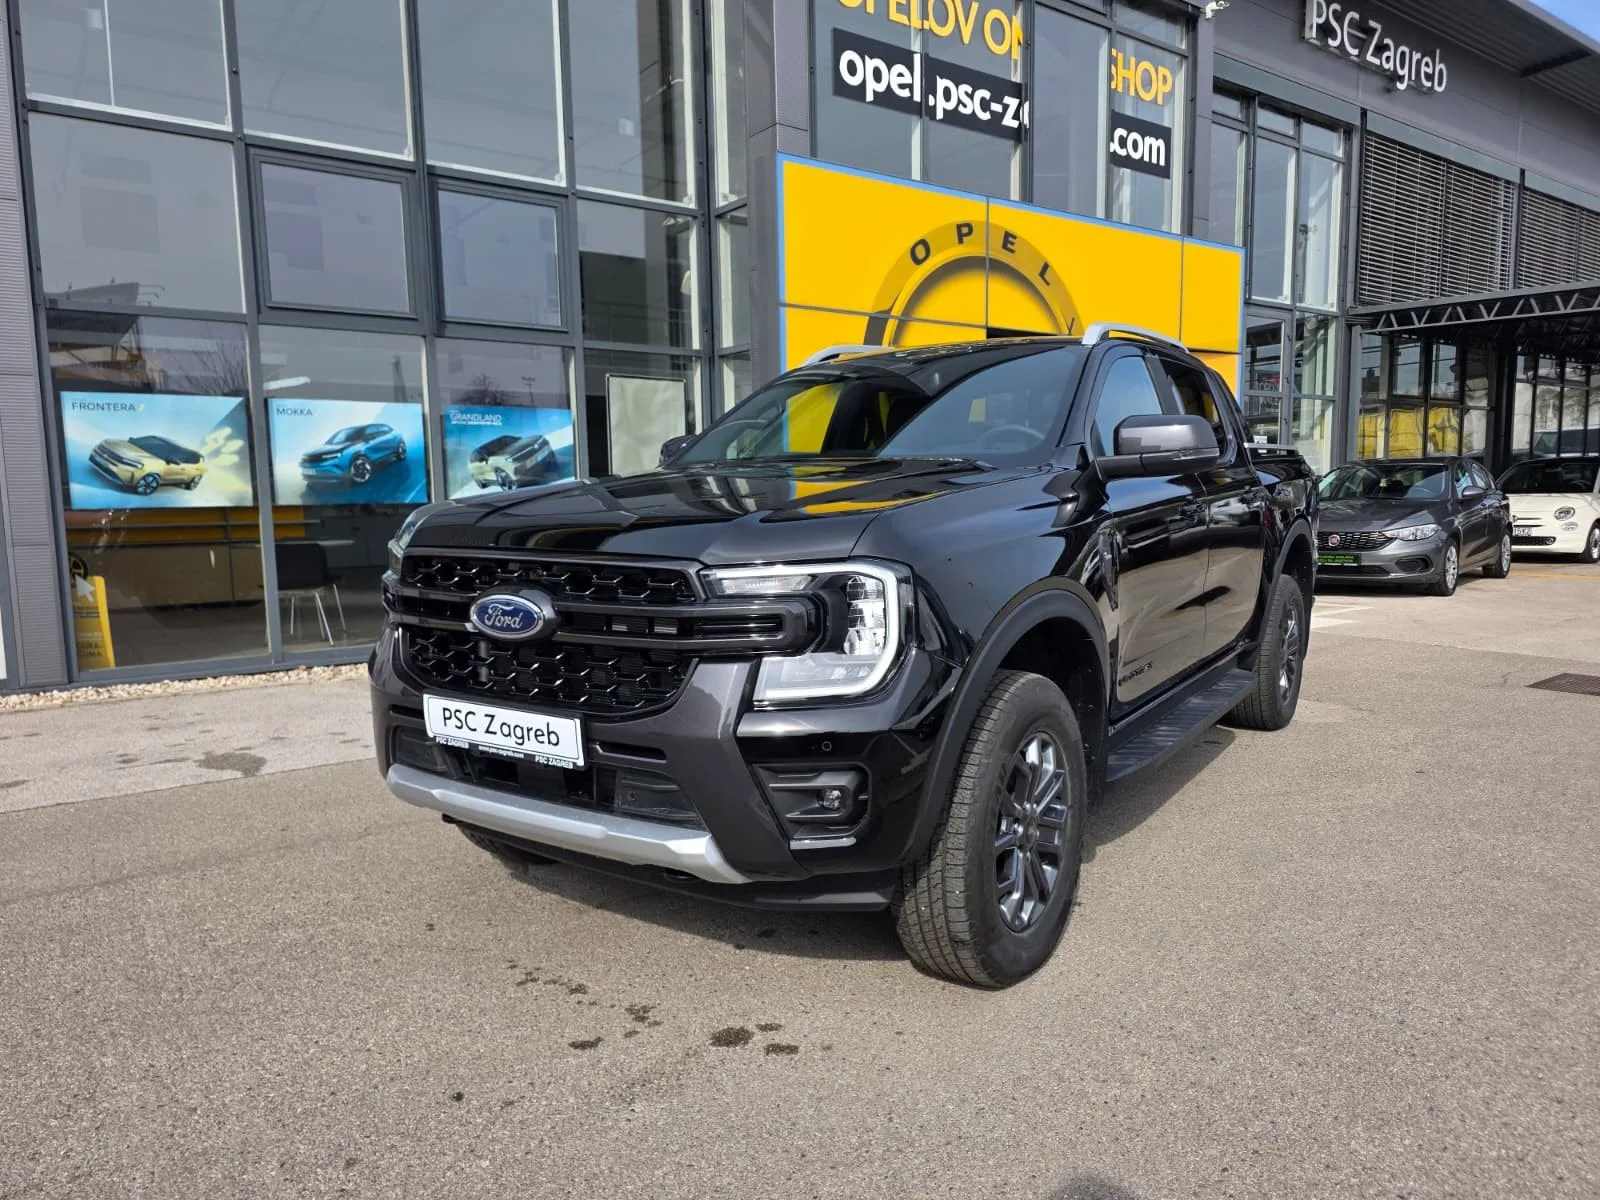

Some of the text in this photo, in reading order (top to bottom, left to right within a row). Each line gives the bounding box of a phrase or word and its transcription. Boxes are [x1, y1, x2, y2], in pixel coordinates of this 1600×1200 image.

[839, 0, 979, 45] ELOV
[1307, 0, 1448, 93] PSC Zagreb
[1109, 127, 1166, 167] .com
[909, 222, 1051, 286] OPEL
[71, 401, 137, 413] FRONTERA
[276, 407, 313, 417] MOKKA
[450, 413, 502, 422] GRANDLAND
[484, 603, 524, 628] Ford
[442, 706, 560, 746] PSC Zagreb
[436, 737, 470, 749] PSC ZAGREB
[535, 756, 573, 769] PSC ZAGREB
